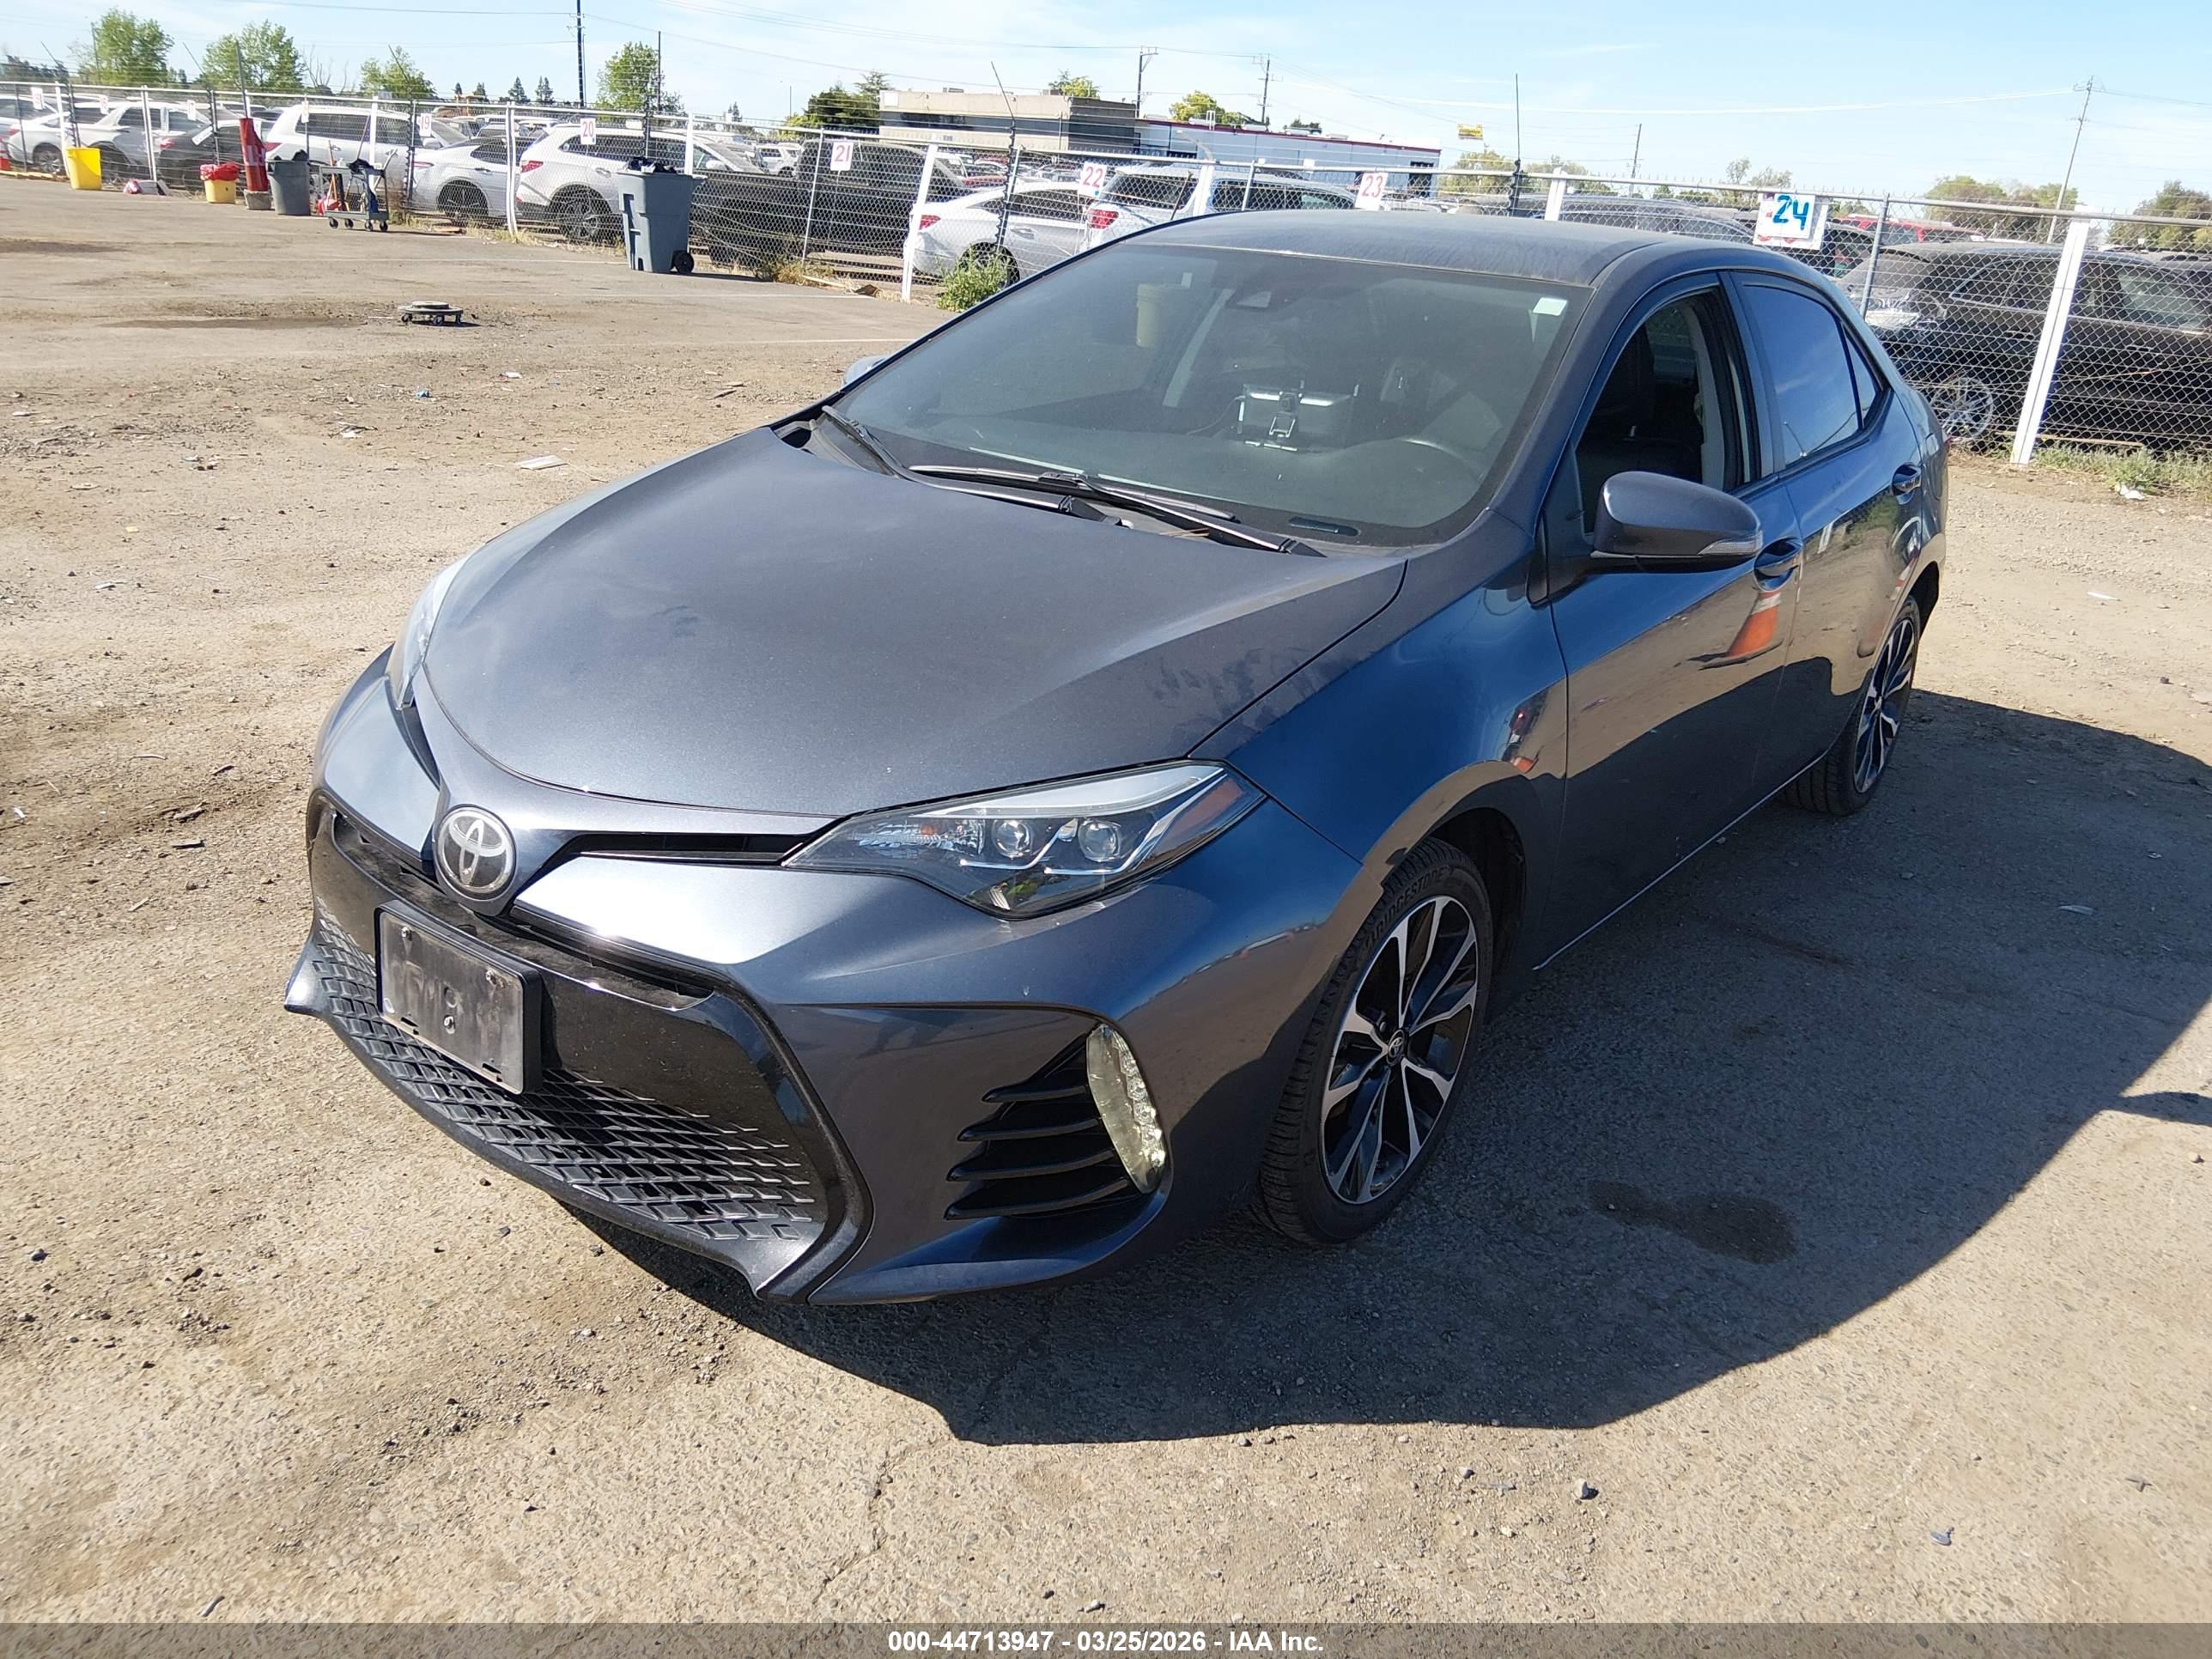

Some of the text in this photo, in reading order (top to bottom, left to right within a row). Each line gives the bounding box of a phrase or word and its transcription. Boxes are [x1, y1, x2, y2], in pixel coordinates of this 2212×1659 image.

[421, 114, 430, 130] 19
[582, 120, 594, 137] 20
[834, 144, 850, 162] 21
[1083, 166, 1103, 188] 22
[1361, 174, 1383, 198] 23
[1771, 194, 1809, 231] 24
